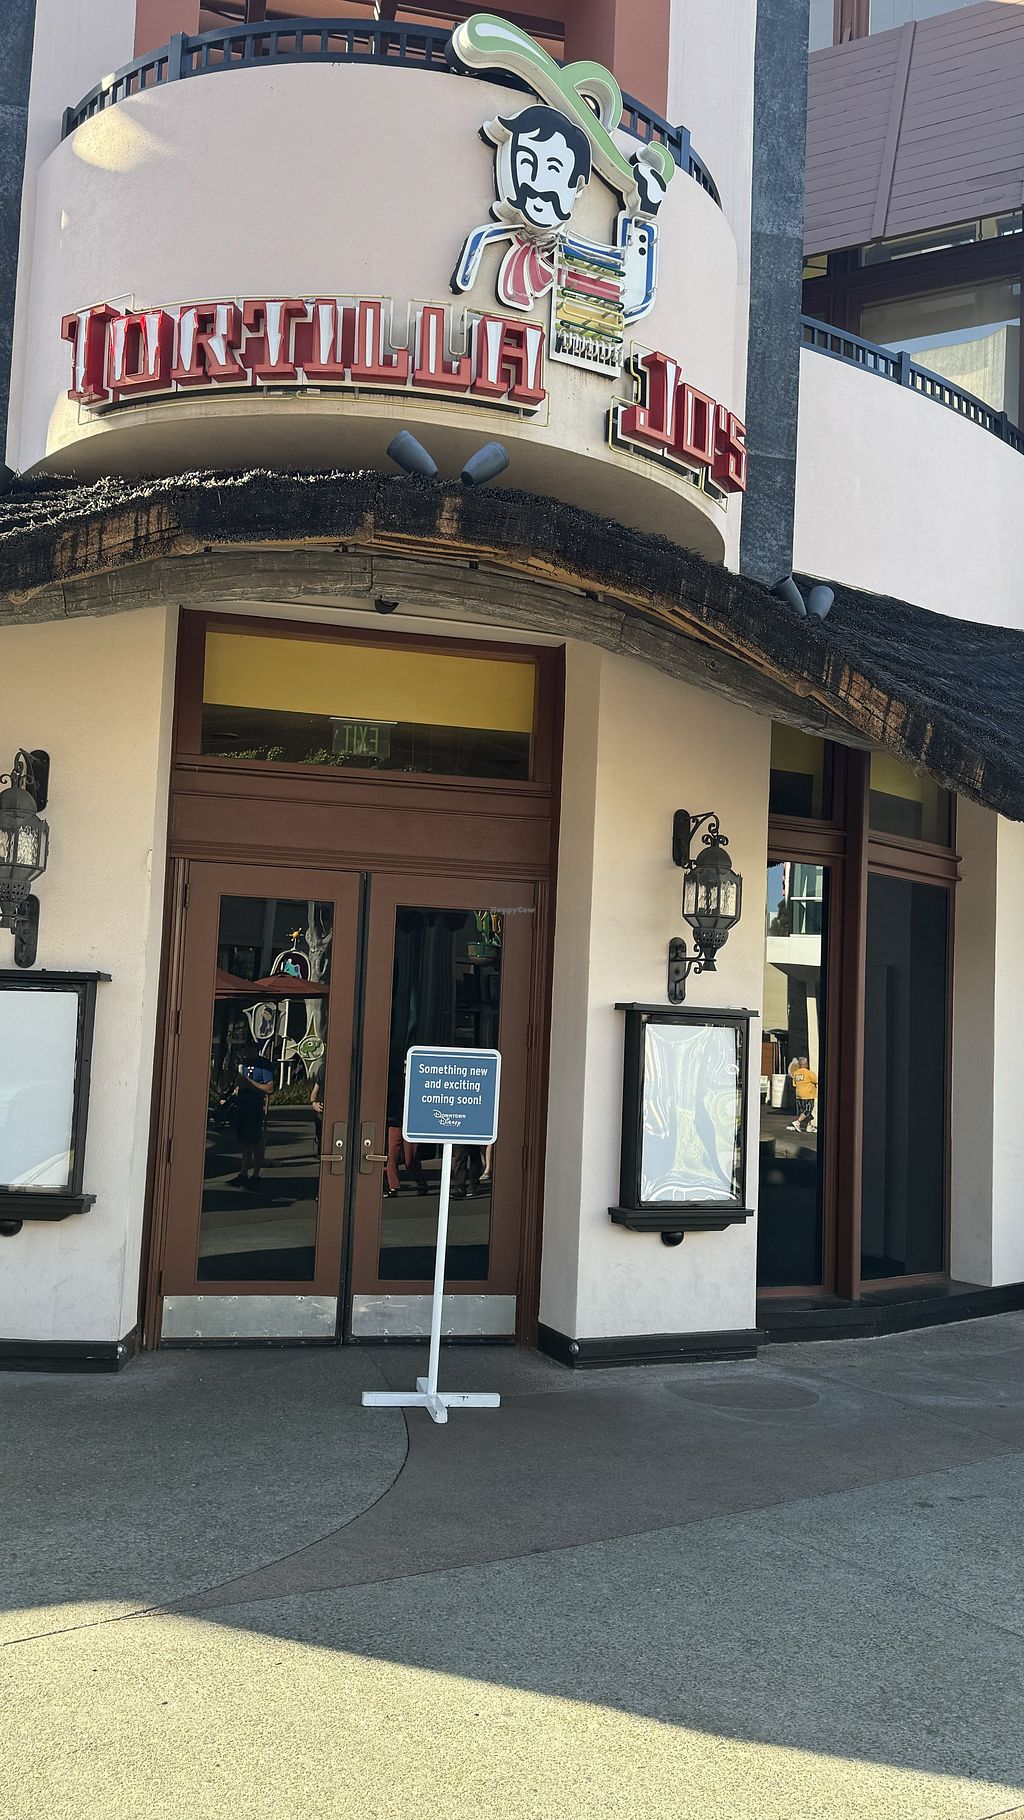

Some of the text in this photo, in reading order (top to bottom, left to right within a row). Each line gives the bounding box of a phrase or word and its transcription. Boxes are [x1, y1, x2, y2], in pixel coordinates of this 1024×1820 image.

[61, 298, 747, 492] TORTILLA JO'S
[419, 1063, 488, 1078] Something new
[424, 1079, 481, 1093] and exciting
[421, 1093, 482, 1106] coming soon!
